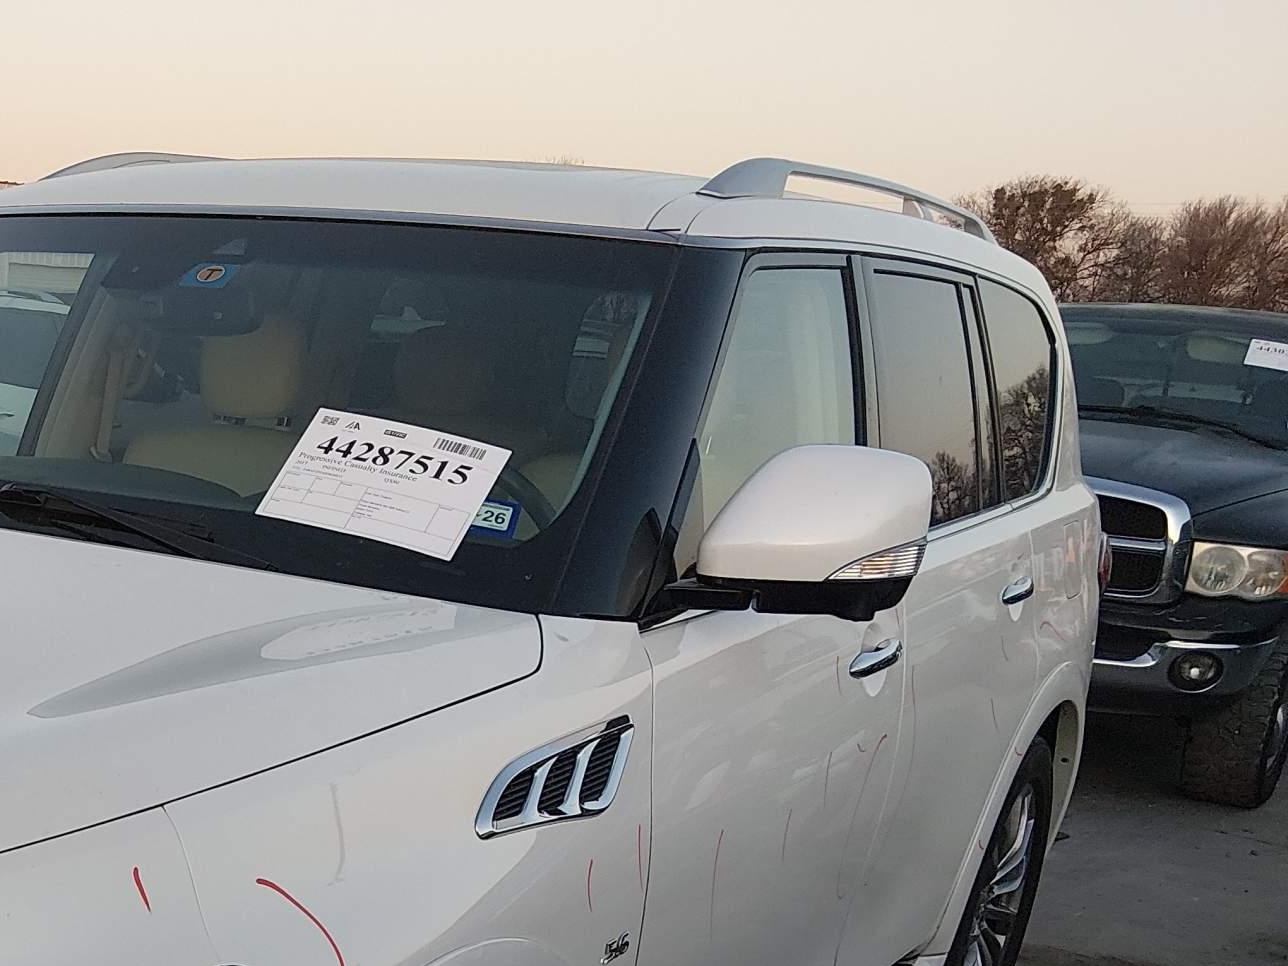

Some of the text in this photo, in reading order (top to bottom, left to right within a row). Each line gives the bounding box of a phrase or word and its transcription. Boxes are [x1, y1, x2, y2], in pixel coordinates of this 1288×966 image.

[298, 451, 343, 465] Progressive
[344, 460, 376, 474] Casualty
[379, 468, 418, 482] Insurance
[316, 436, 474, 485] 44287515
[482, 510, 507, 525] 26
